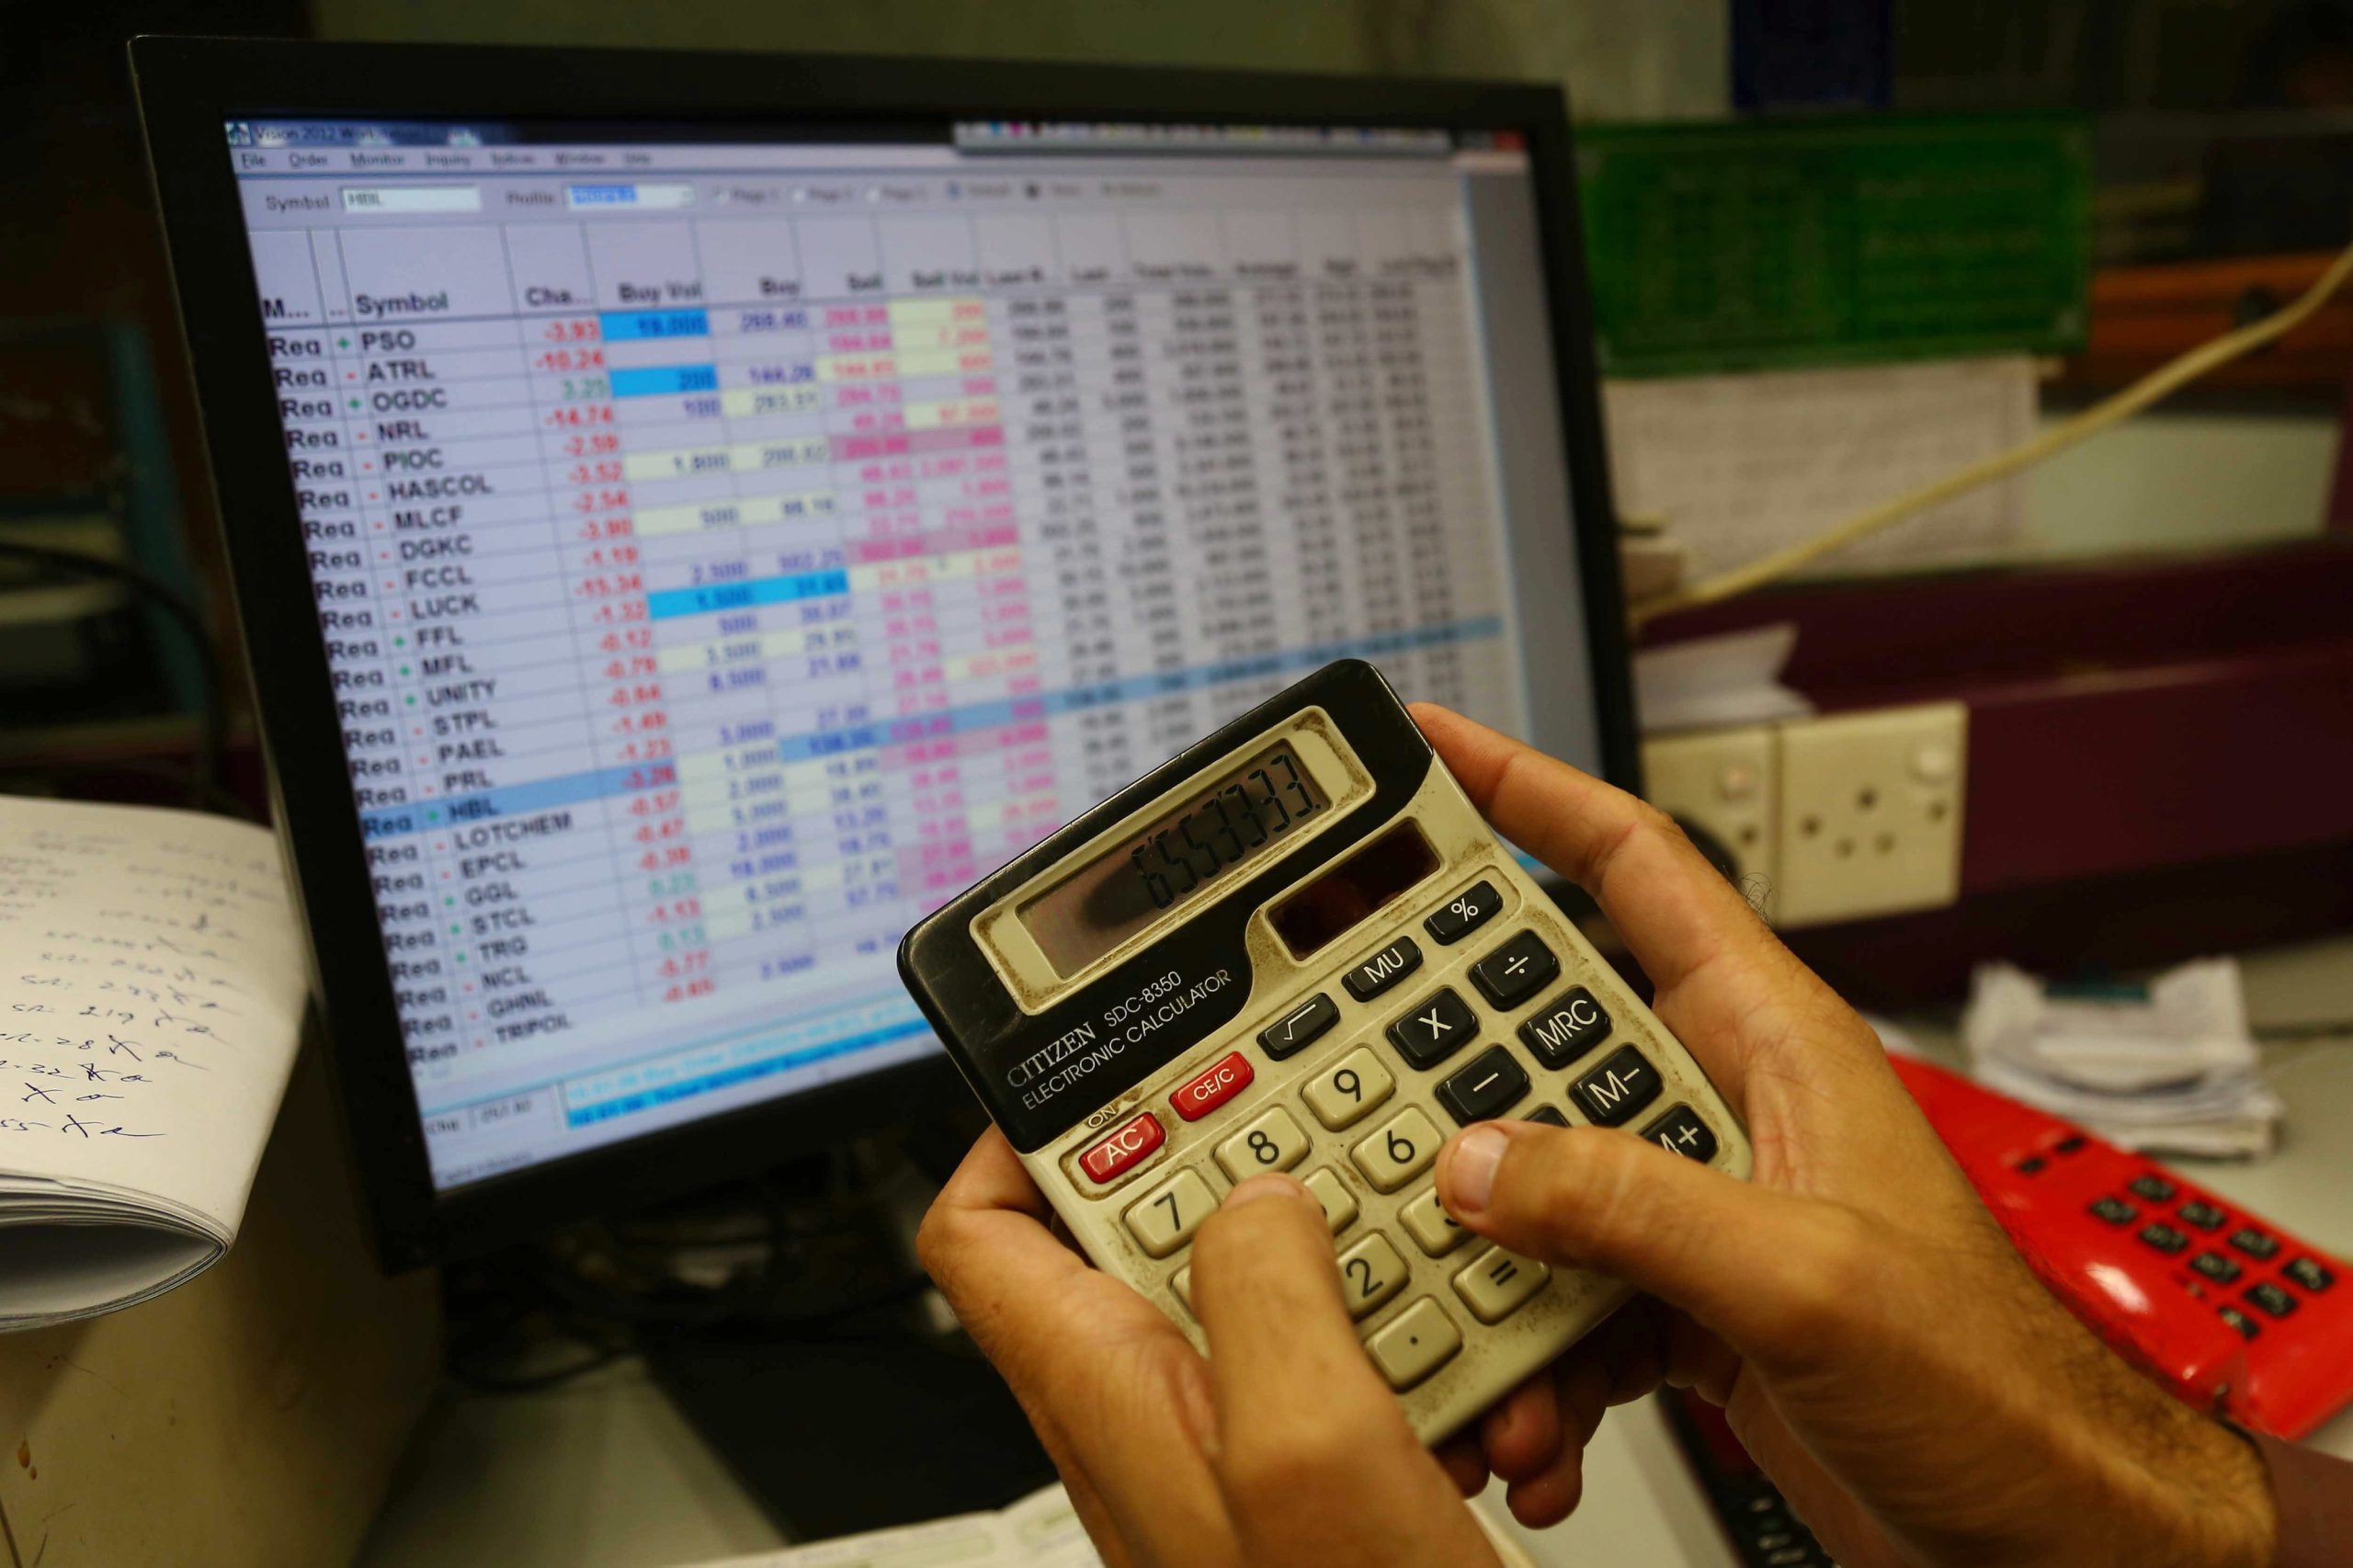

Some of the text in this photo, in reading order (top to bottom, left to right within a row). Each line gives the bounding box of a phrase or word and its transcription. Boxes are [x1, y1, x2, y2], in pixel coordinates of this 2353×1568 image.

[242, 153, 266, 169] File
[289, 153, 328, 168] Order
[350, 153, 404, 168] Monitor
[267, 195, 330, 213] Symbol
[356, 293, 449, 319] Symbol
[620, 284, 660, 306] Buy
[668, 281, 701, 301] Vol
[760, 278, 801, 298] Buy
[361, 331, 415, 351] PSO
[369, 360, 436, 381] ATRL
[372, 389, 448, 412] OGDC
[378, 421, 429, 441] NRL
[384, 449, 443, 471] PIOC
[389, 474, 494, 502] HASCOL
[394, 506, 462, 529] MLCF
[400, 535, 472, 561] DGKC
[405, 566, 472, 589] FCCL
[411, 595, 480, 620] LUCK
[416, 626, 463, 648] FFL
[422, 654, 474, 677] MFL
[426, 679, 496, 707] UNITY
[434, 710, 498, 736] STPL
[438, 738, 505, 763] PAEL
[444, 770, 494, 791] PRL
[449, 799, 499, 823] HBL
[454, 812, 573, 851] LOTCHEM
[461, 853, 527, 879] EPCL
[472, 908, 535, 936] STCL
[1450, 897, 1479, 922] %
[1362, 949, 1405, 984] MU
[1007, 1021, 1097, 1088] CITIZEN
[1104, 971, 1182, 1028] SDC-8350
[1417, 1007, 1452, 1040] X
[1535, 999, 1597, 1051] MRC
[1022, 1038, 1125, 1110] ELECTRONIC
[1126, 969, 1232, 1043] CALCULATOR
[1193, 1068, 1234, 1101] CE/C
[1333, 1068, 1361, 1103] 9
[1588, 1067, 1641, 1109] M-
[1087, 1105, 1118, 1128] ON
[1105, 1128, 1144, 1166] AC
[1247, 1130, 1279, 1165] 8
[1386, 1130, 1415, 1164] 6
[1154, 1191, 1181, 1232] 7
[1346, 1257, 1383, 1298] 2
